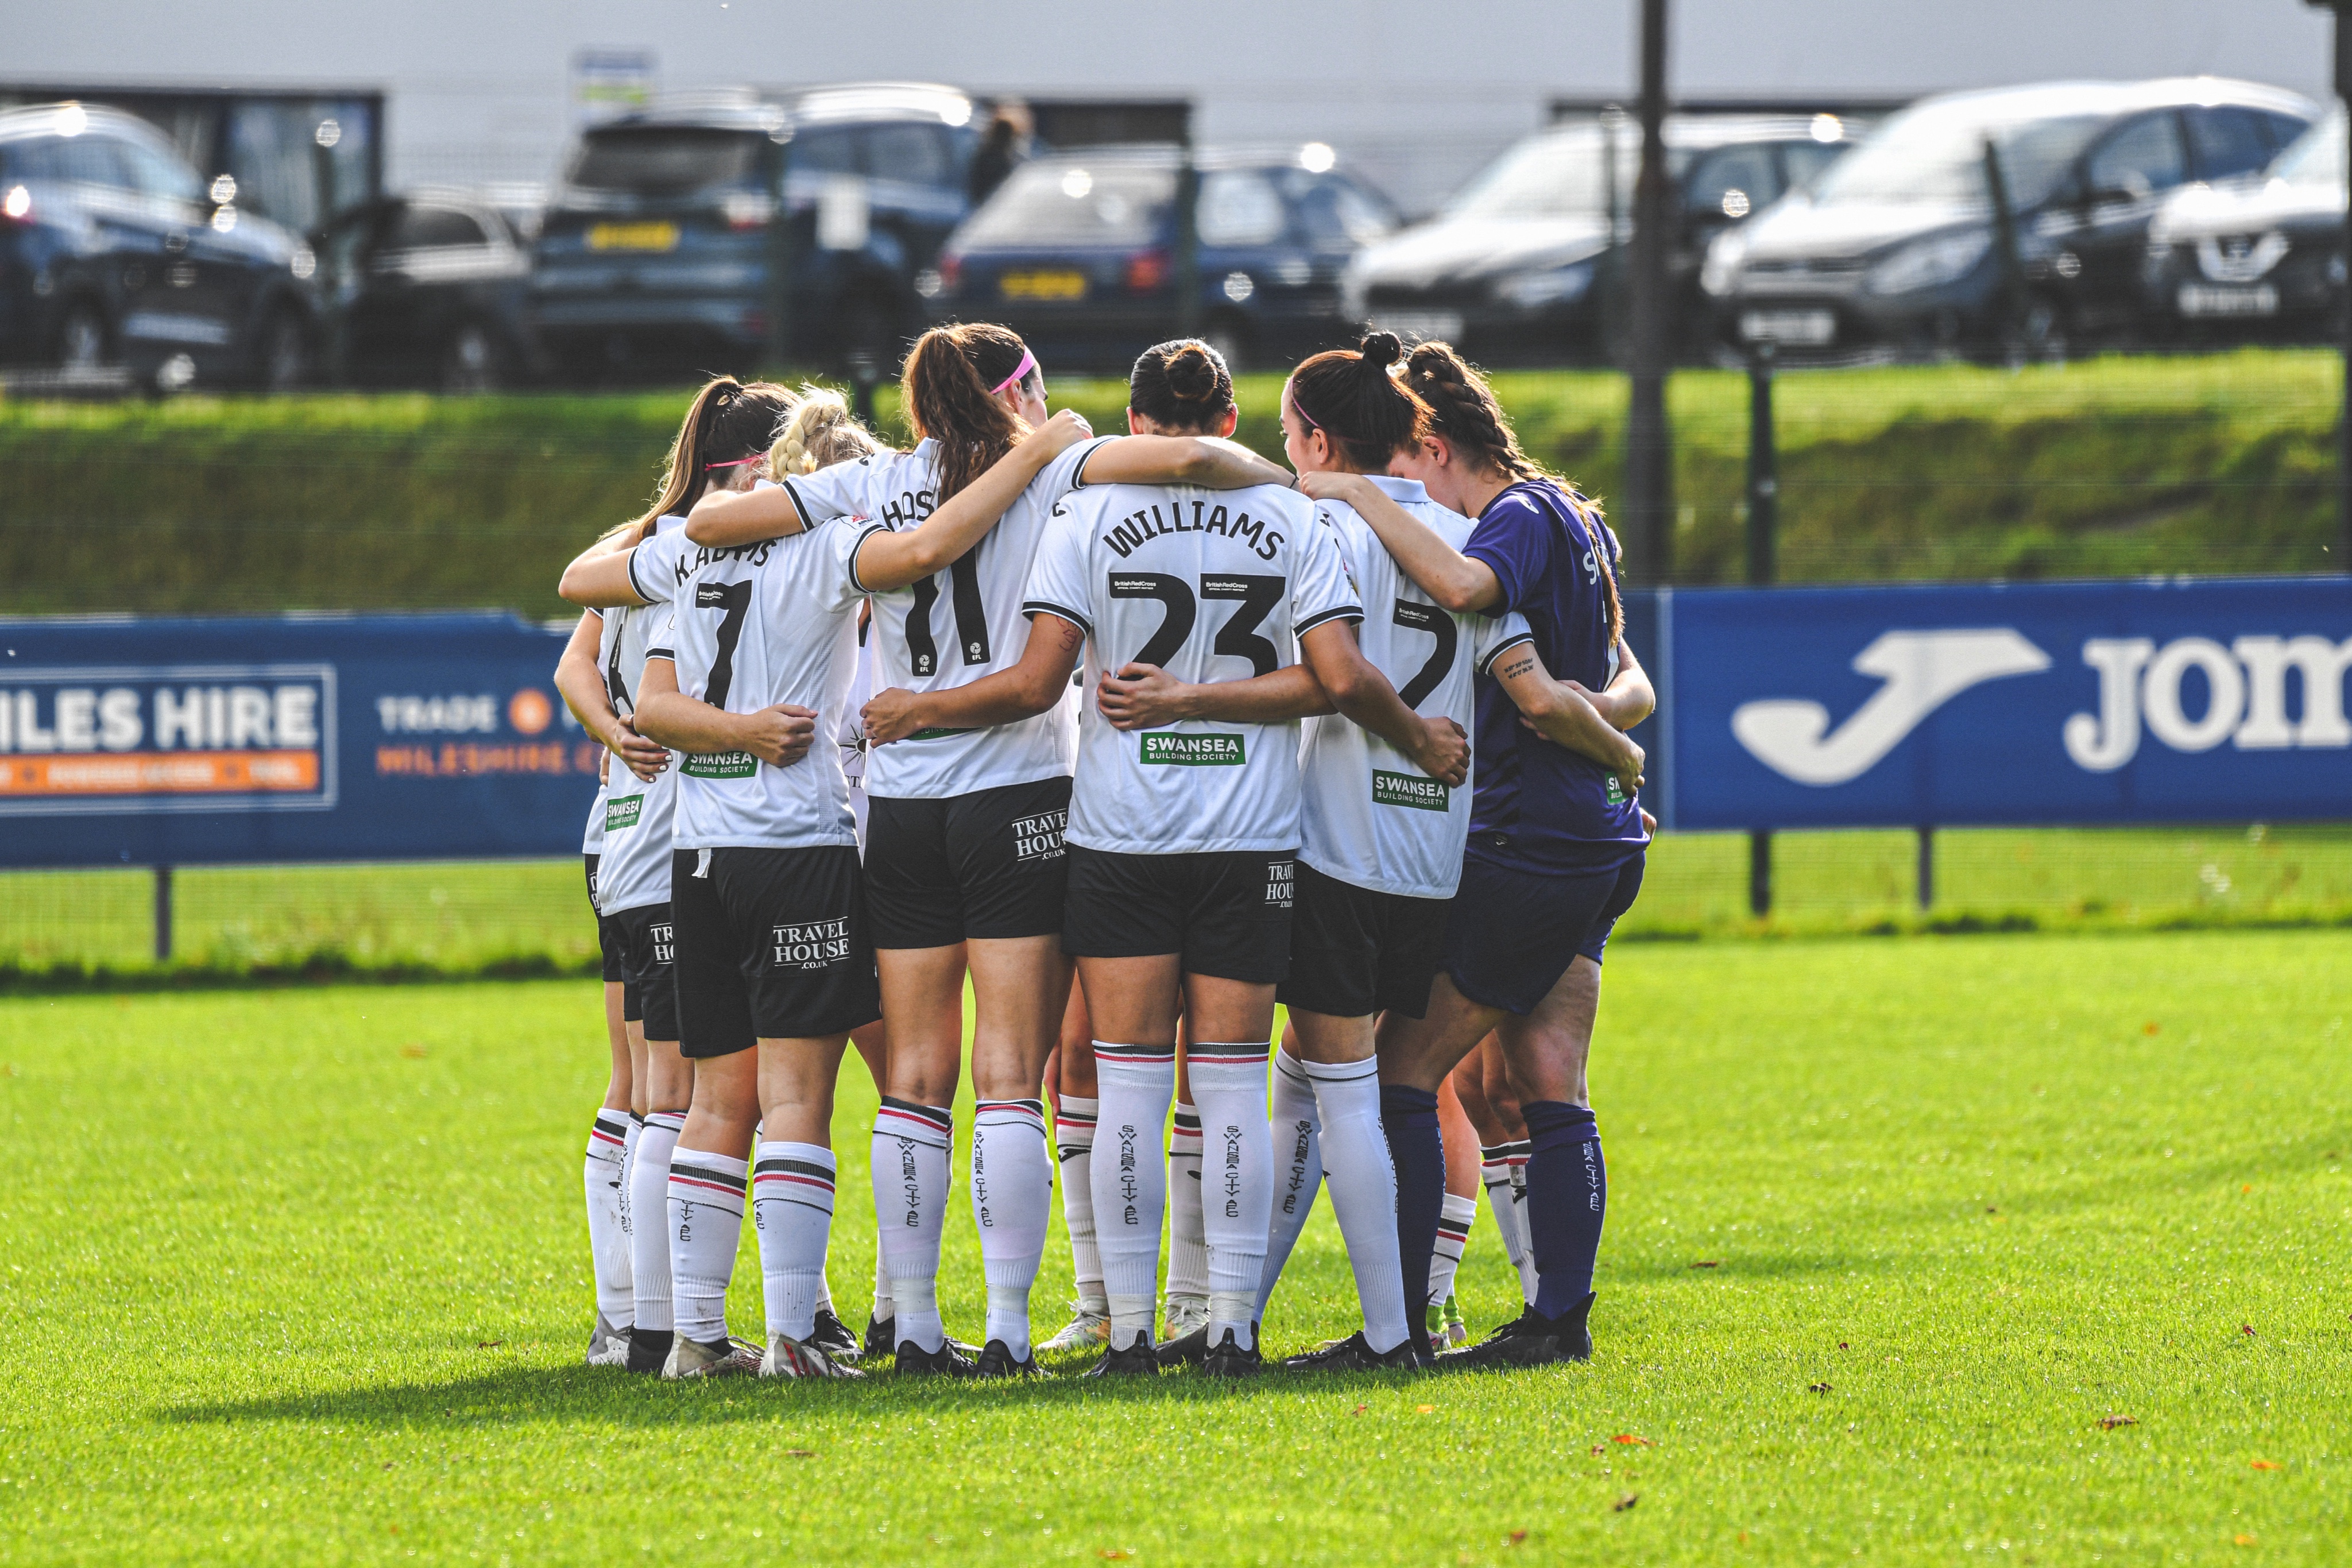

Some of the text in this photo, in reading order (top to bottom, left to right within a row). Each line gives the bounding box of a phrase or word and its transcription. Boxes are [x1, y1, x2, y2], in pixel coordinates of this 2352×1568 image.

[1102, 501, 1285, 560] WILLIAMS
[1109, 572, 1286, 679] 23
[695, 579, 752, 711] 7
[1392, 598, 1457, 711] 2
[153, 686, 318, 750] HIRE
[1146, 738, 1239, 753] SWANSEA
[689, 765, 717, 773] BUILDING
[690, 752, 753, 765] SWANSEA
[1375, 776, 1445, 797] SWANSEA
[608, 800, 640, 818] SWANSEA
[1378, 791, 1443, 806] BUILDING SOCIETY
[1042, 848, 1066, 860] .CO.UK
[773, 921, 849, 944] TRAVEL
[773, 938, 849, 962] HOUSE
[801, 960, 828, 969] .CO.UK
[974, 1131, 984, 1175] SWANSEA
[1118, 1125, 1138, 1172] SWANSEA
[1223, 1125, 1243, 1169] SWANSEA
